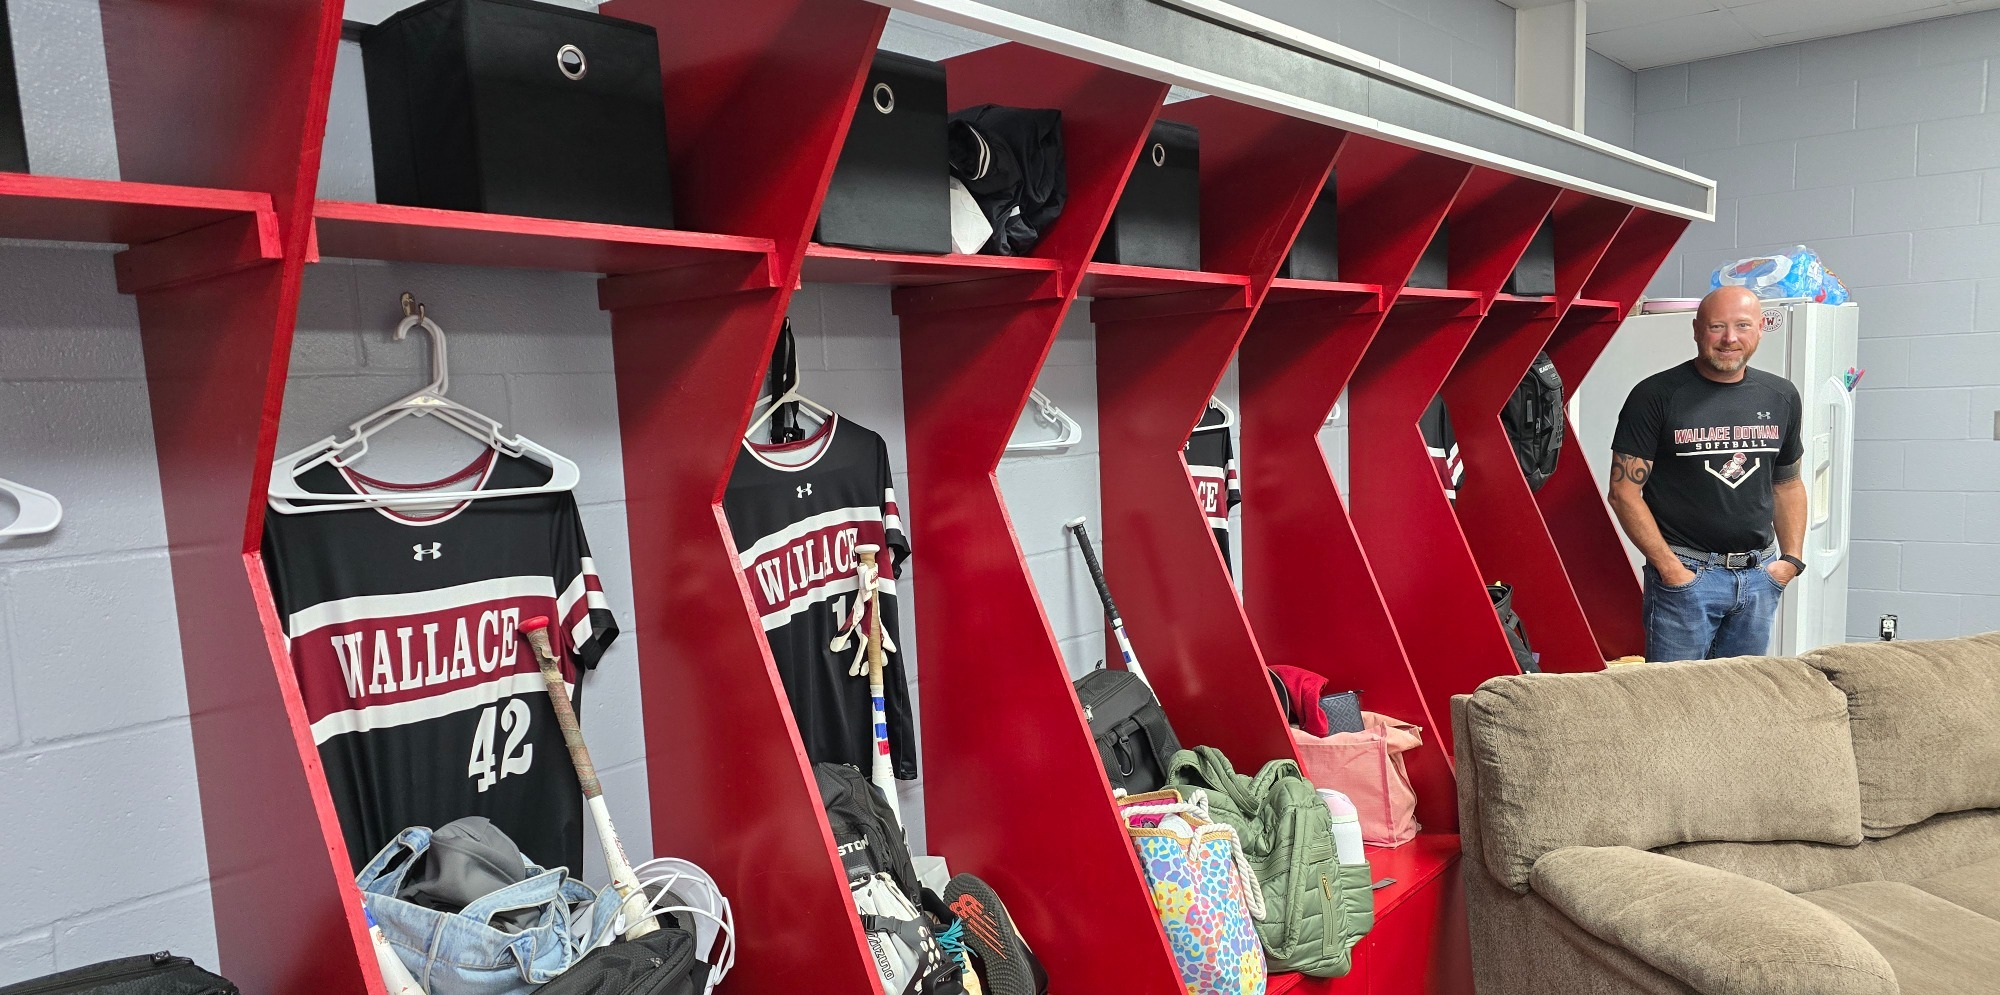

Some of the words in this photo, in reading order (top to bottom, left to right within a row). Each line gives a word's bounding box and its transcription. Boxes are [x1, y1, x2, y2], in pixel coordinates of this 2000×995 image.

[1766, 317, 1775, 326] W
[1674, 425, 1731, 444] WALLACE
[1733, 425, 1779, 440] DOTHAN
[1695, 439, 1767, 450] SOFTBALL
[331, 607, 520, 699] WALLACE
[468, 698, 533, 793] 42
[837, 833, 869, 857] STON
